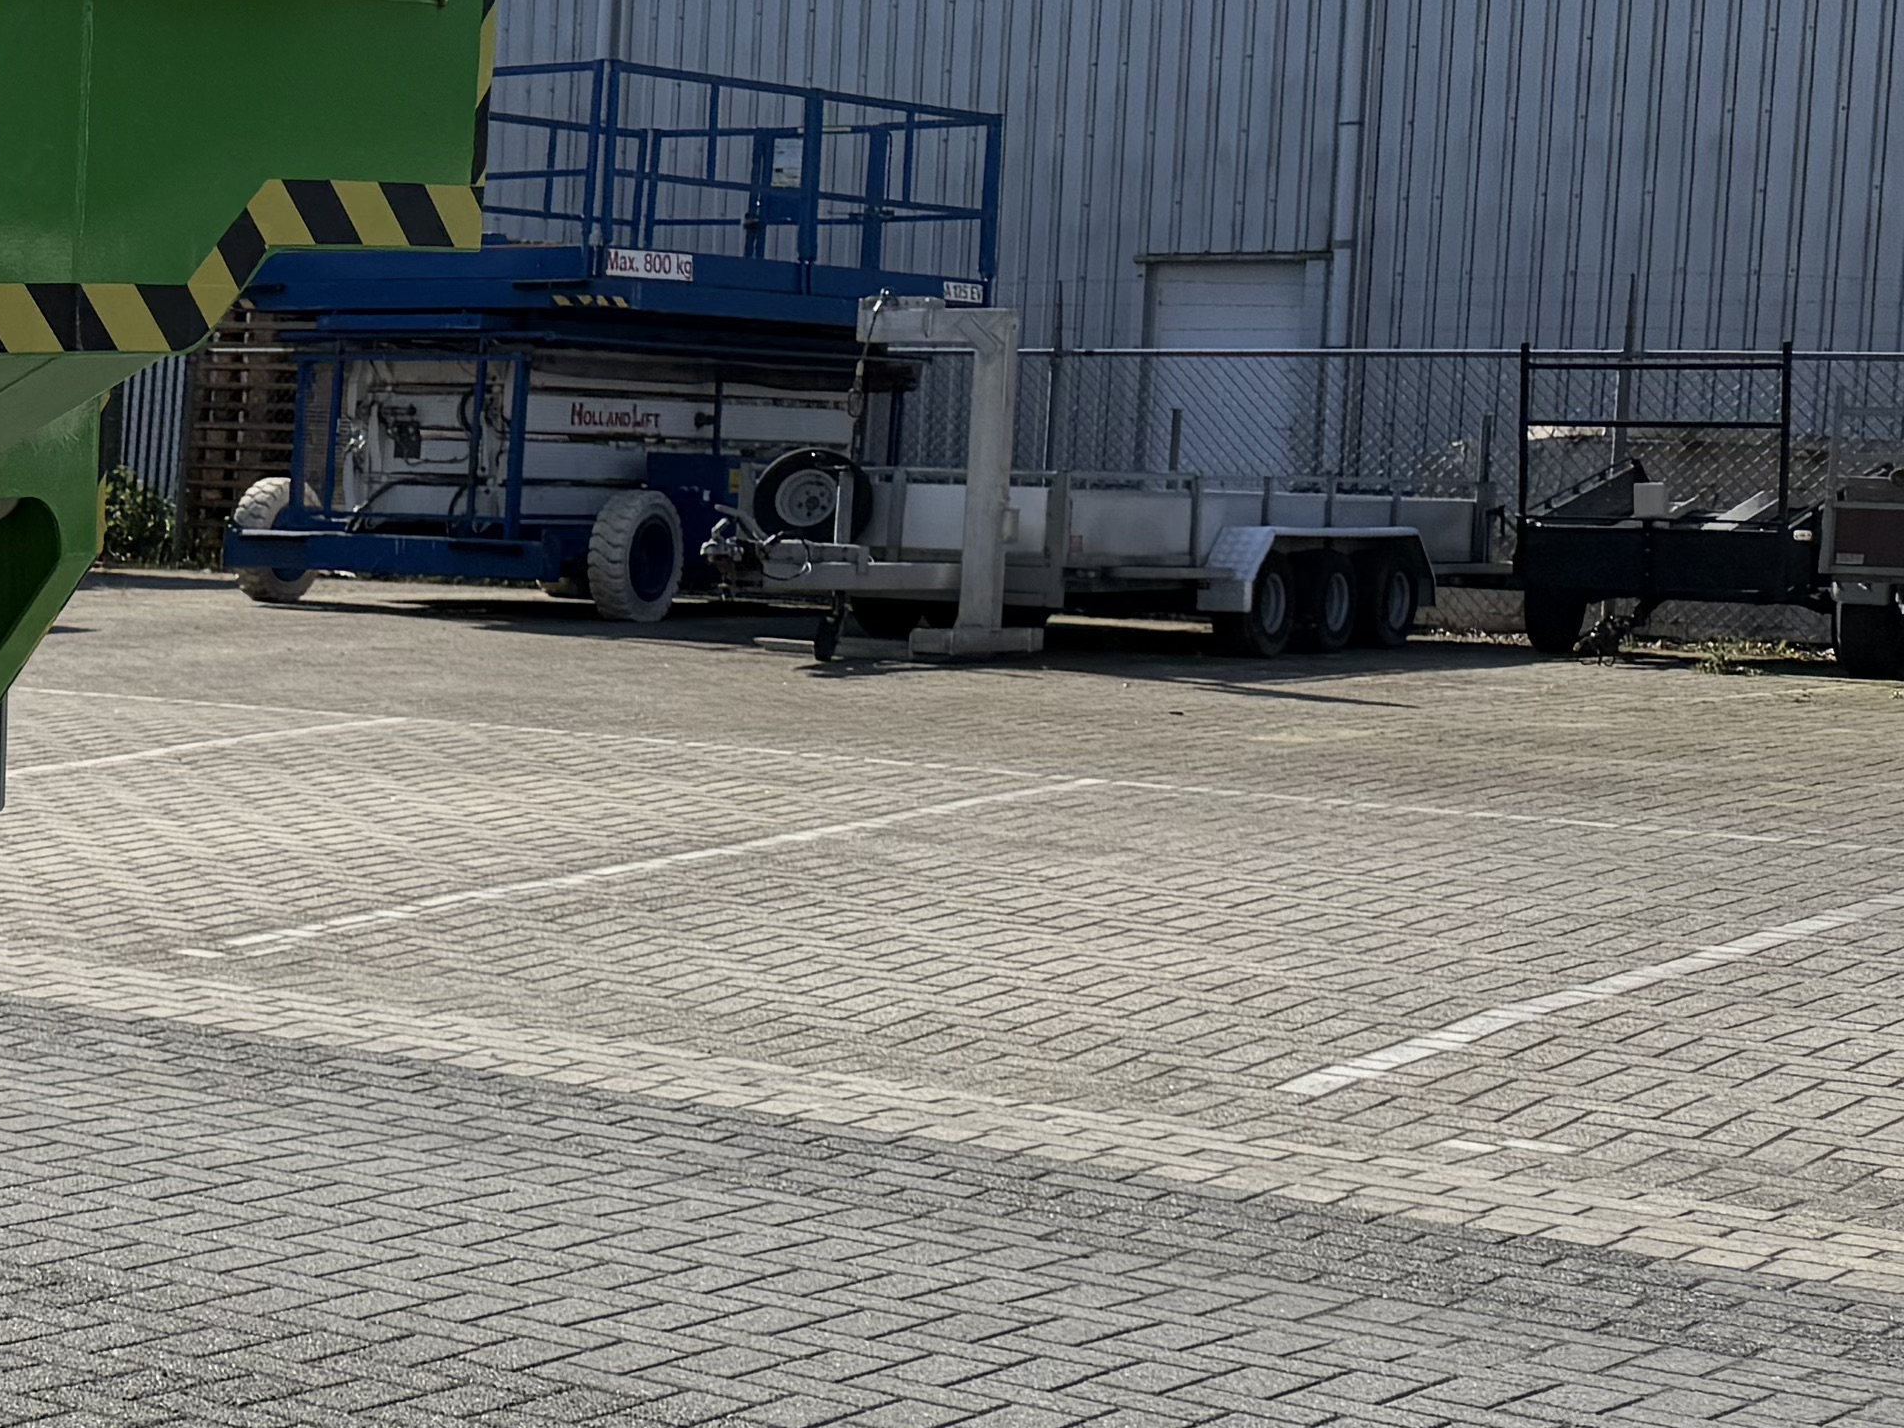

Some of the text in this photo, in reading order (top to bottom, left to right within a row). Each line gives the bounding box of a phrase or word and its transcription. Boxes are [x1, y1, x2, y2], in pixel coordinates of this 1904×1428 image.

[608, 250, 692, 280] Max. 800 kg
